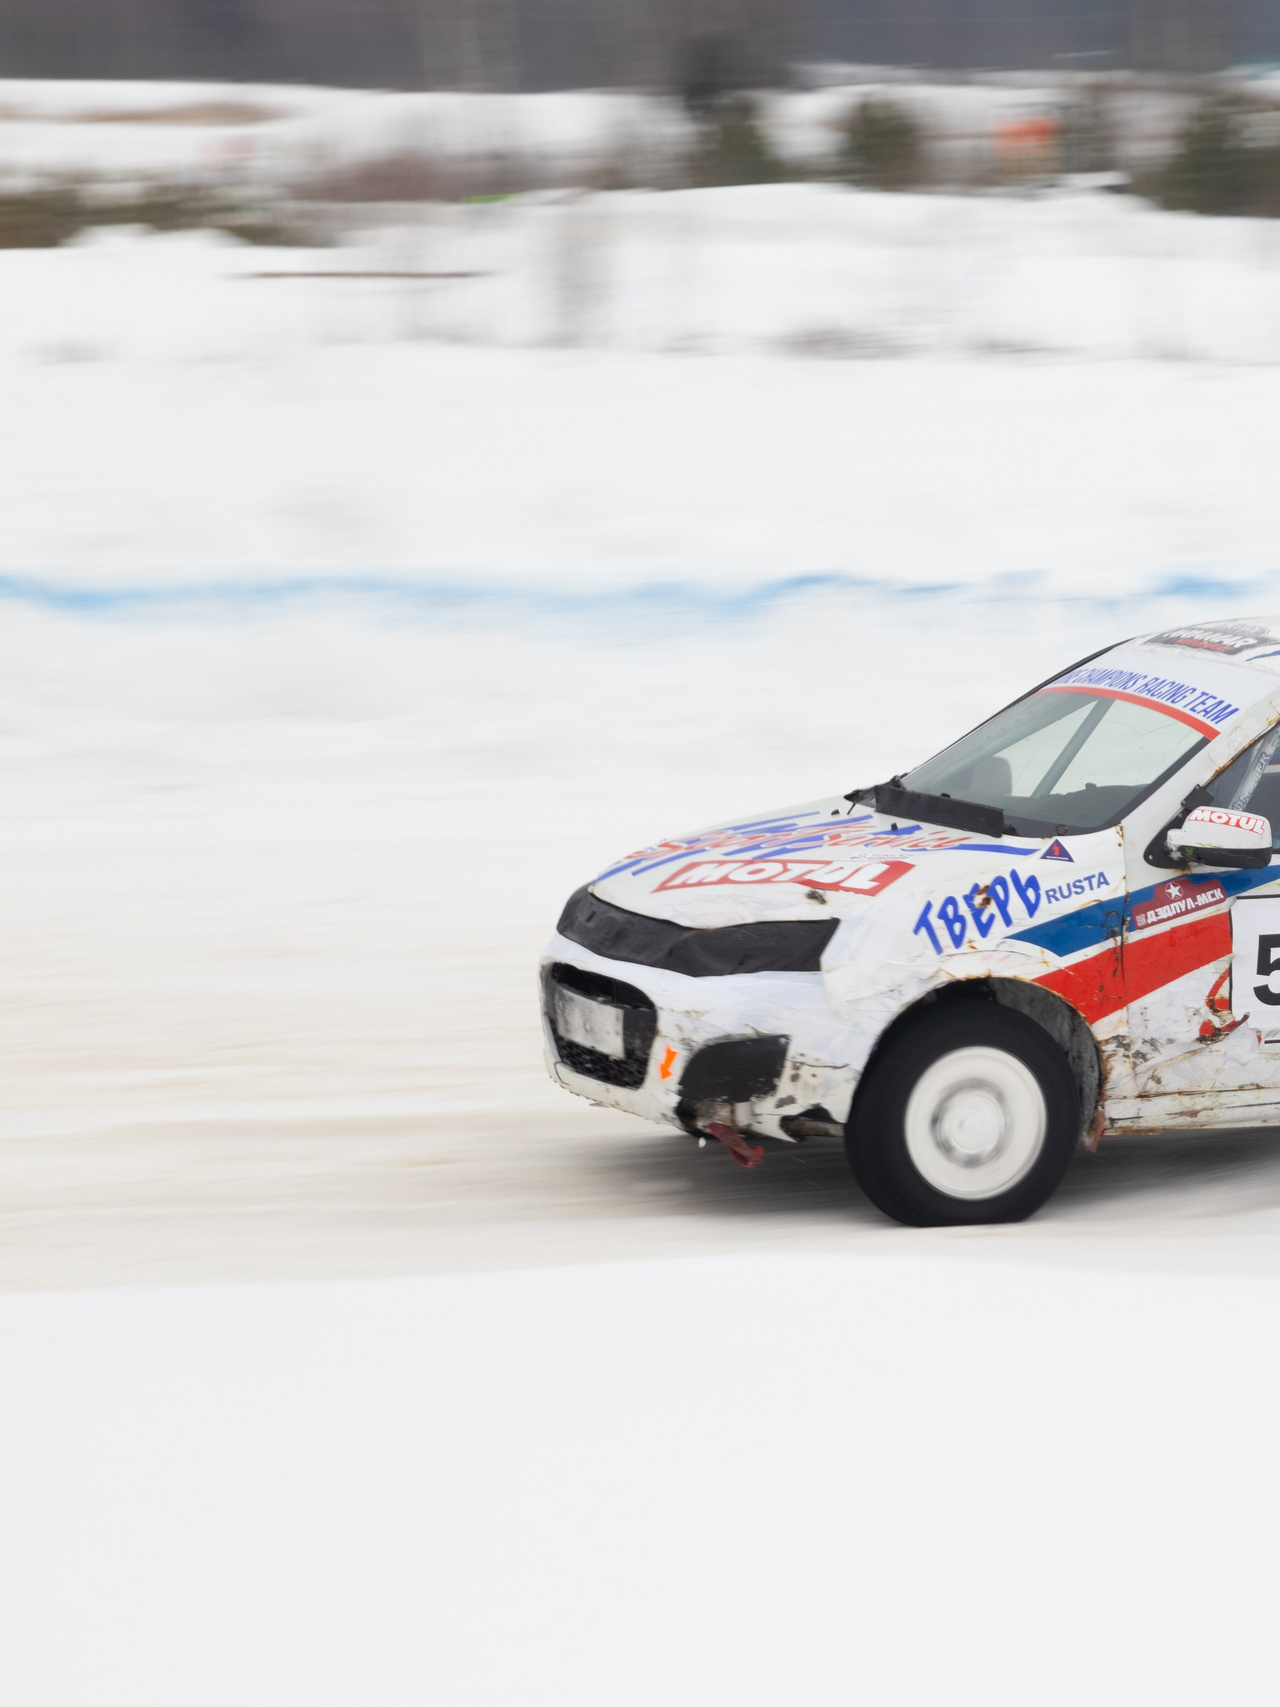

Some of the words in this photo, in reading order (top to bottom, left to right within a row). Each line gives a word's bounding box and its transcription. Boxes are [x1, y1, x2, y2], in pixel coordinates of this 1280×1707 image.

[1136, 677, 1196, 703] RACING
[1184, 691, 1240, 725] TEAM
[1189, 808, 1266, 836] MOTUL
[664, 861, 892, 891] MOTUL
[1045, 871, 1111, 905] RUSTA
[913, 868, 1042, 955] ТВЕРЬ
[1146, 887, 1225, 924] ДЭДПУЛ-МСК
